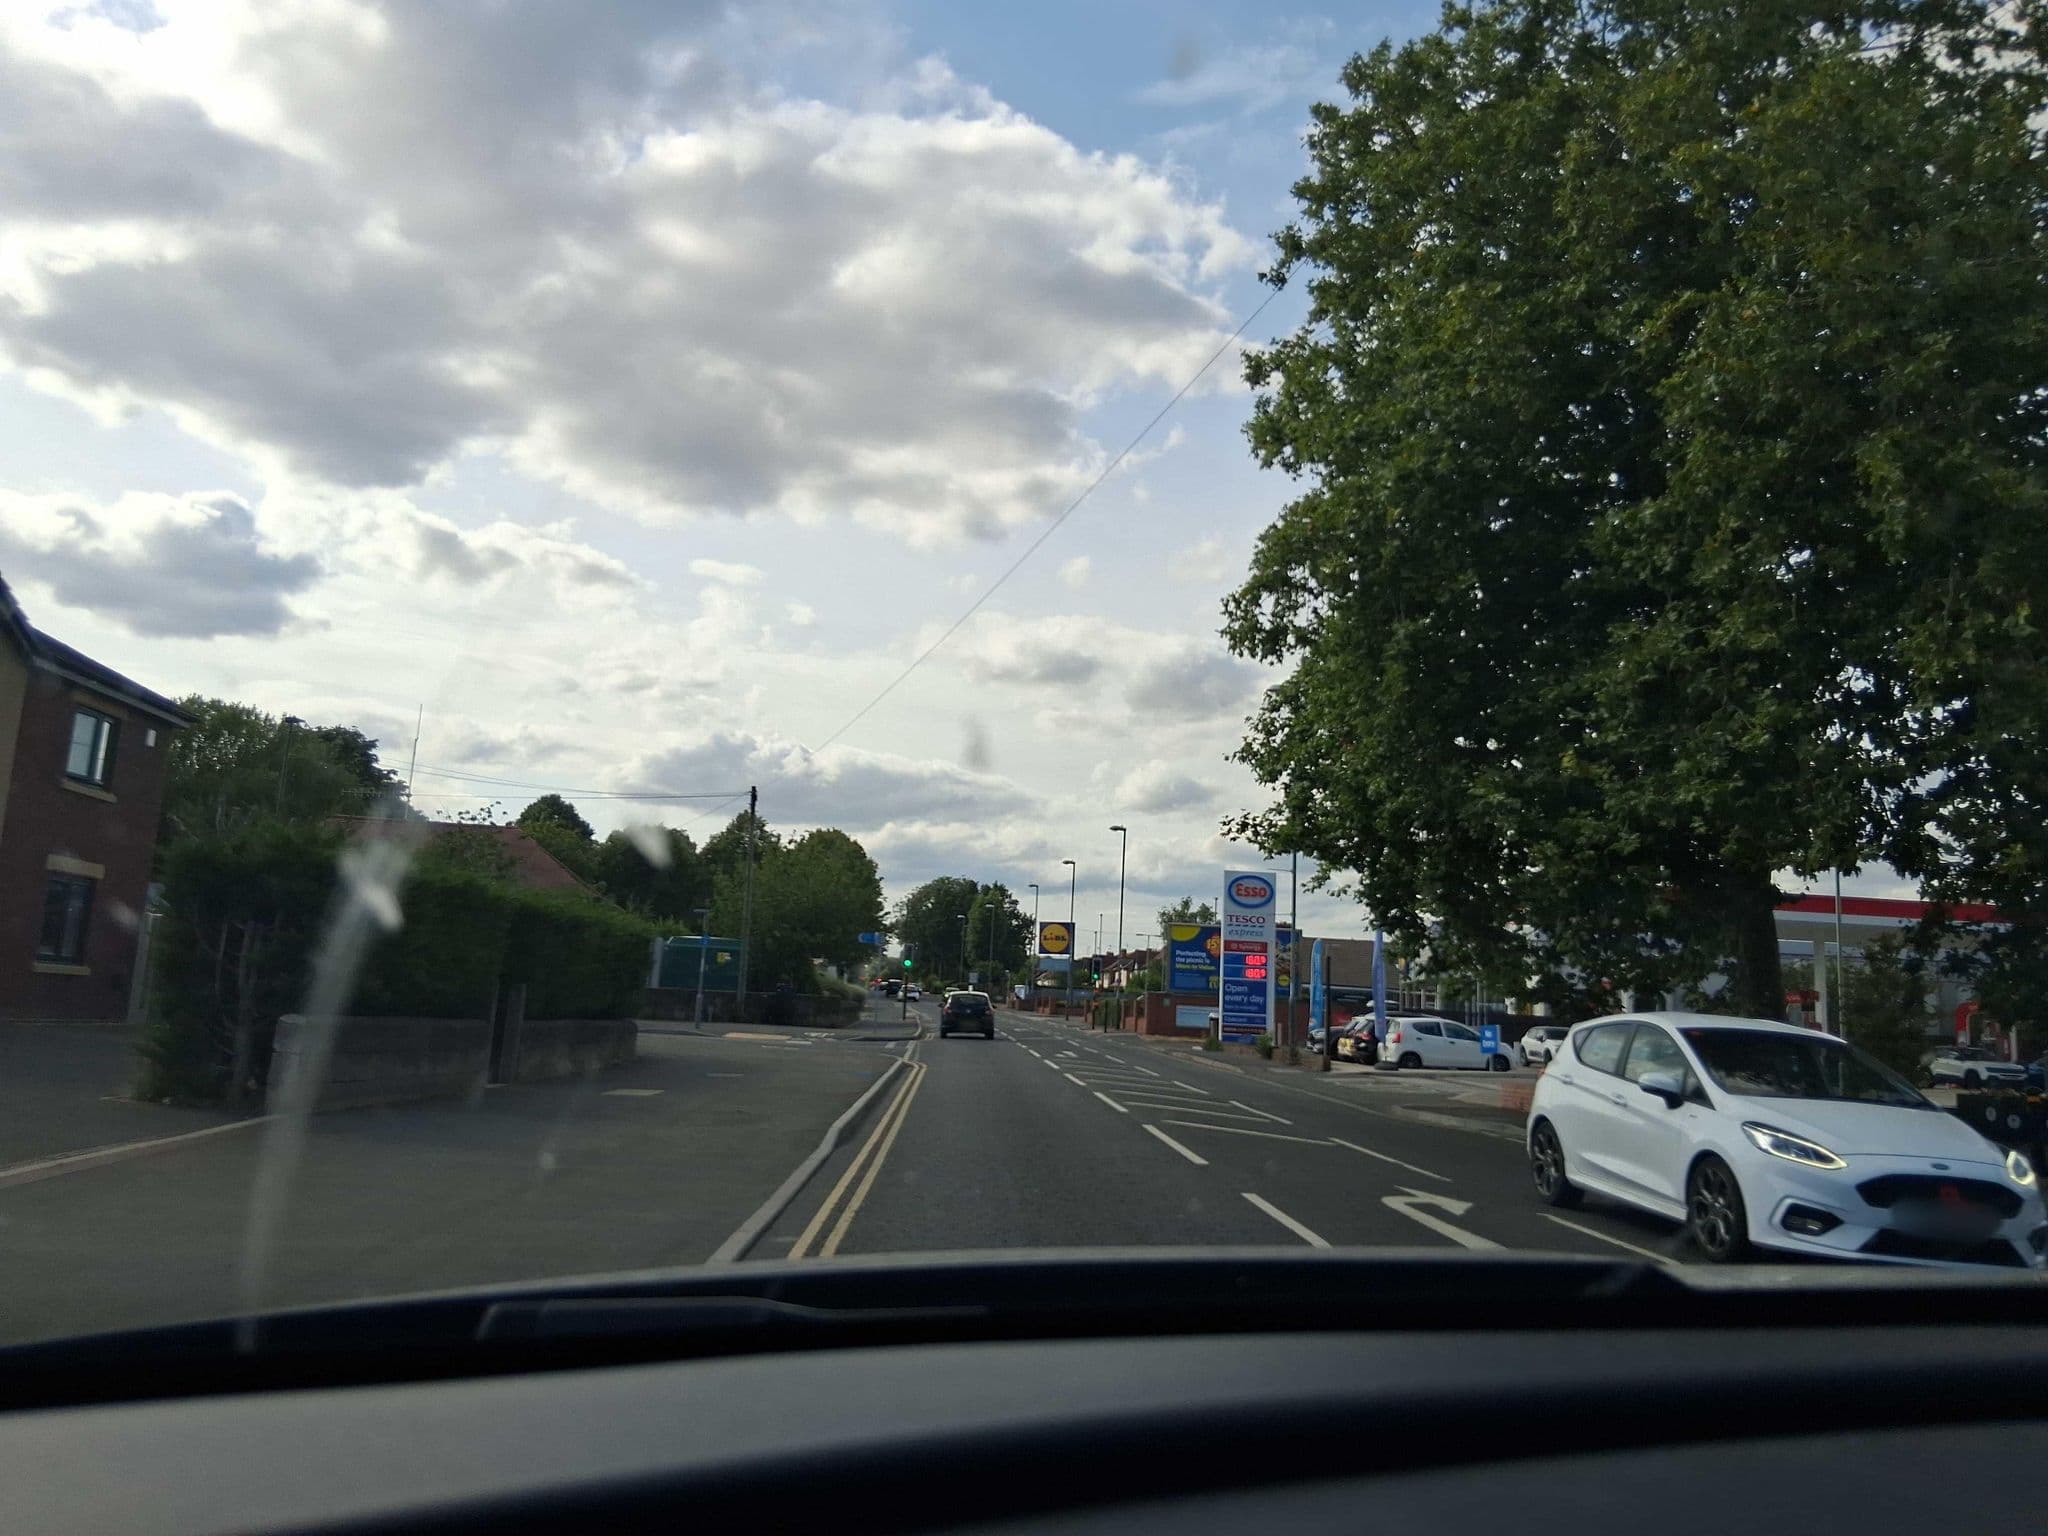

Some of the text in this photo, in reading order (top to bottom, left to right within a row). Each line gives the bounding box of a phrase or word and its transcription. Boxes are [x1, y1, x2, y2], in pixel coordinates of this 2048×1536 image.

[1235, 883, 1267, 898] Esso
[1227, 914, 1266, 924] TESCO
[1228, 929, 1264, 937] express
[1224, 983, 1248, 993] Open
[1224, 995, 1265, 1005] every day
